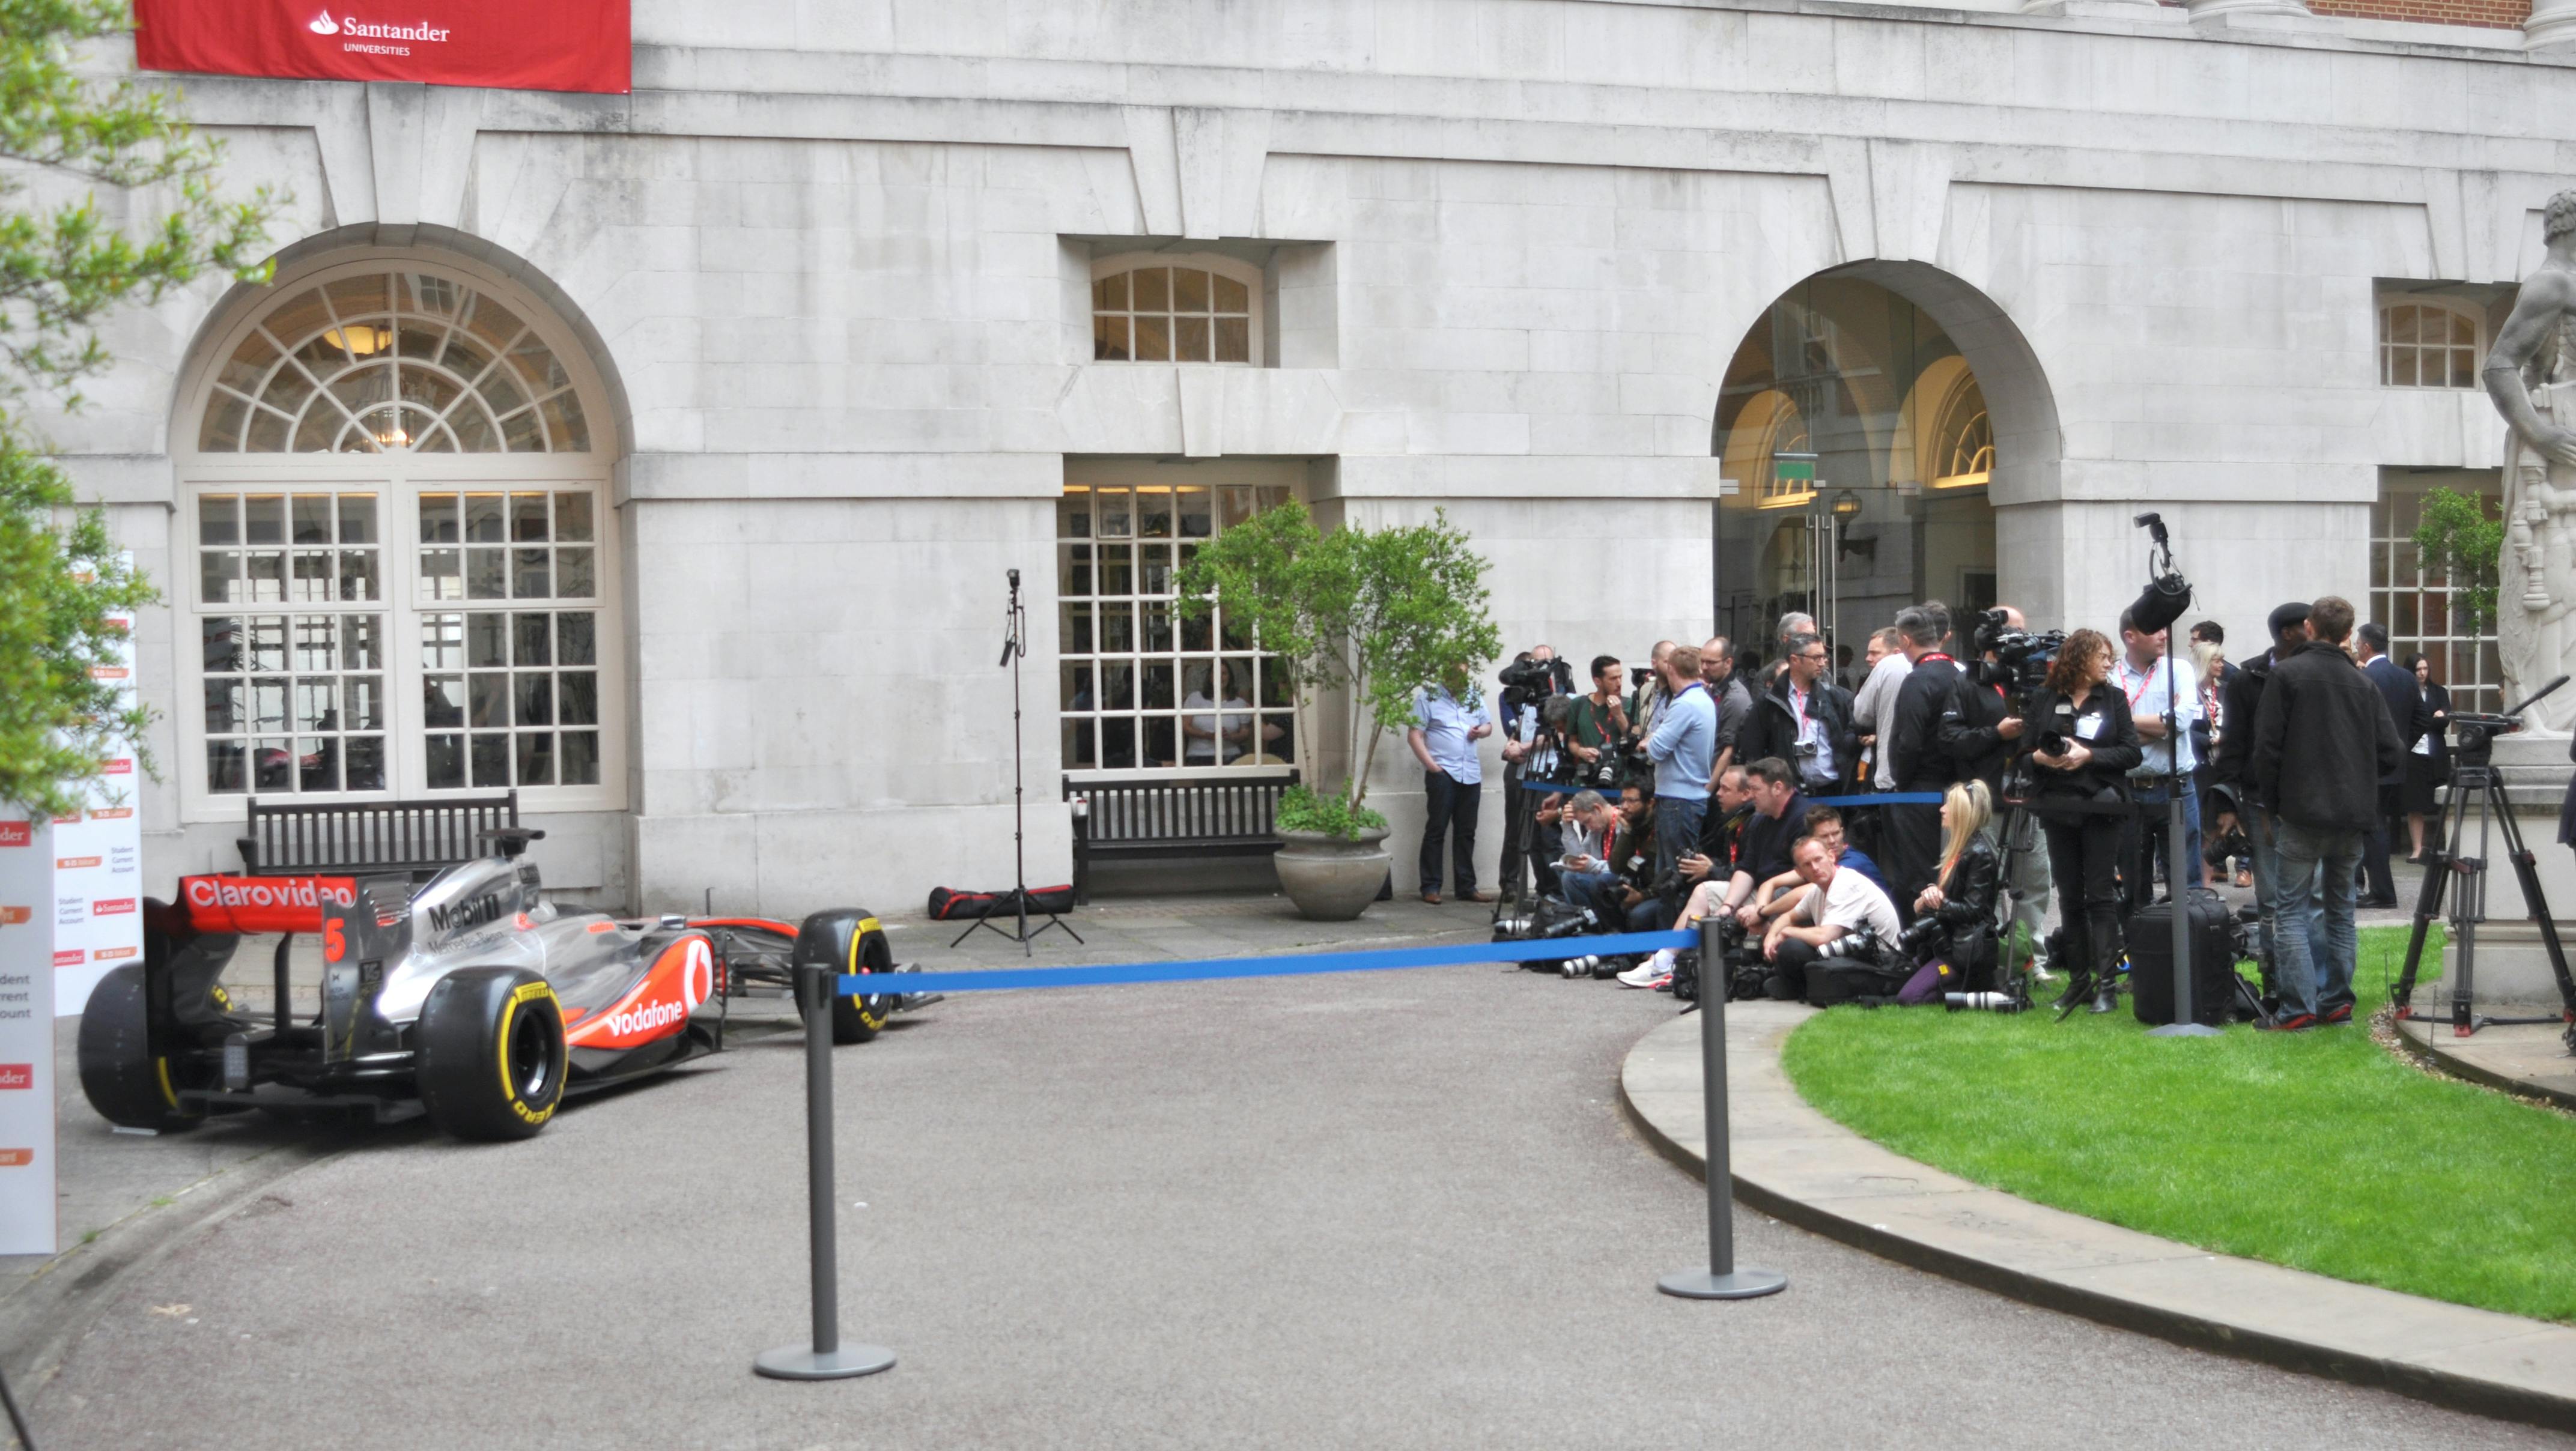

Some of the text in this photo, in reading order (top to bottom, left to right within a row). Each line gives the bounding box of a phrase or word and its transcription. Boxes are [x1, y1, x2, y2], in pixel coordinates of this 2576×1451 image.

[344, 17, 450, 41] Santander
[344, 43, 410, 56] UNIVERSITIES
[428, 897, 481, 931] Mobil
[326, 918, 345, 963] 5
[605, 999, 682, 1037] vodafone
